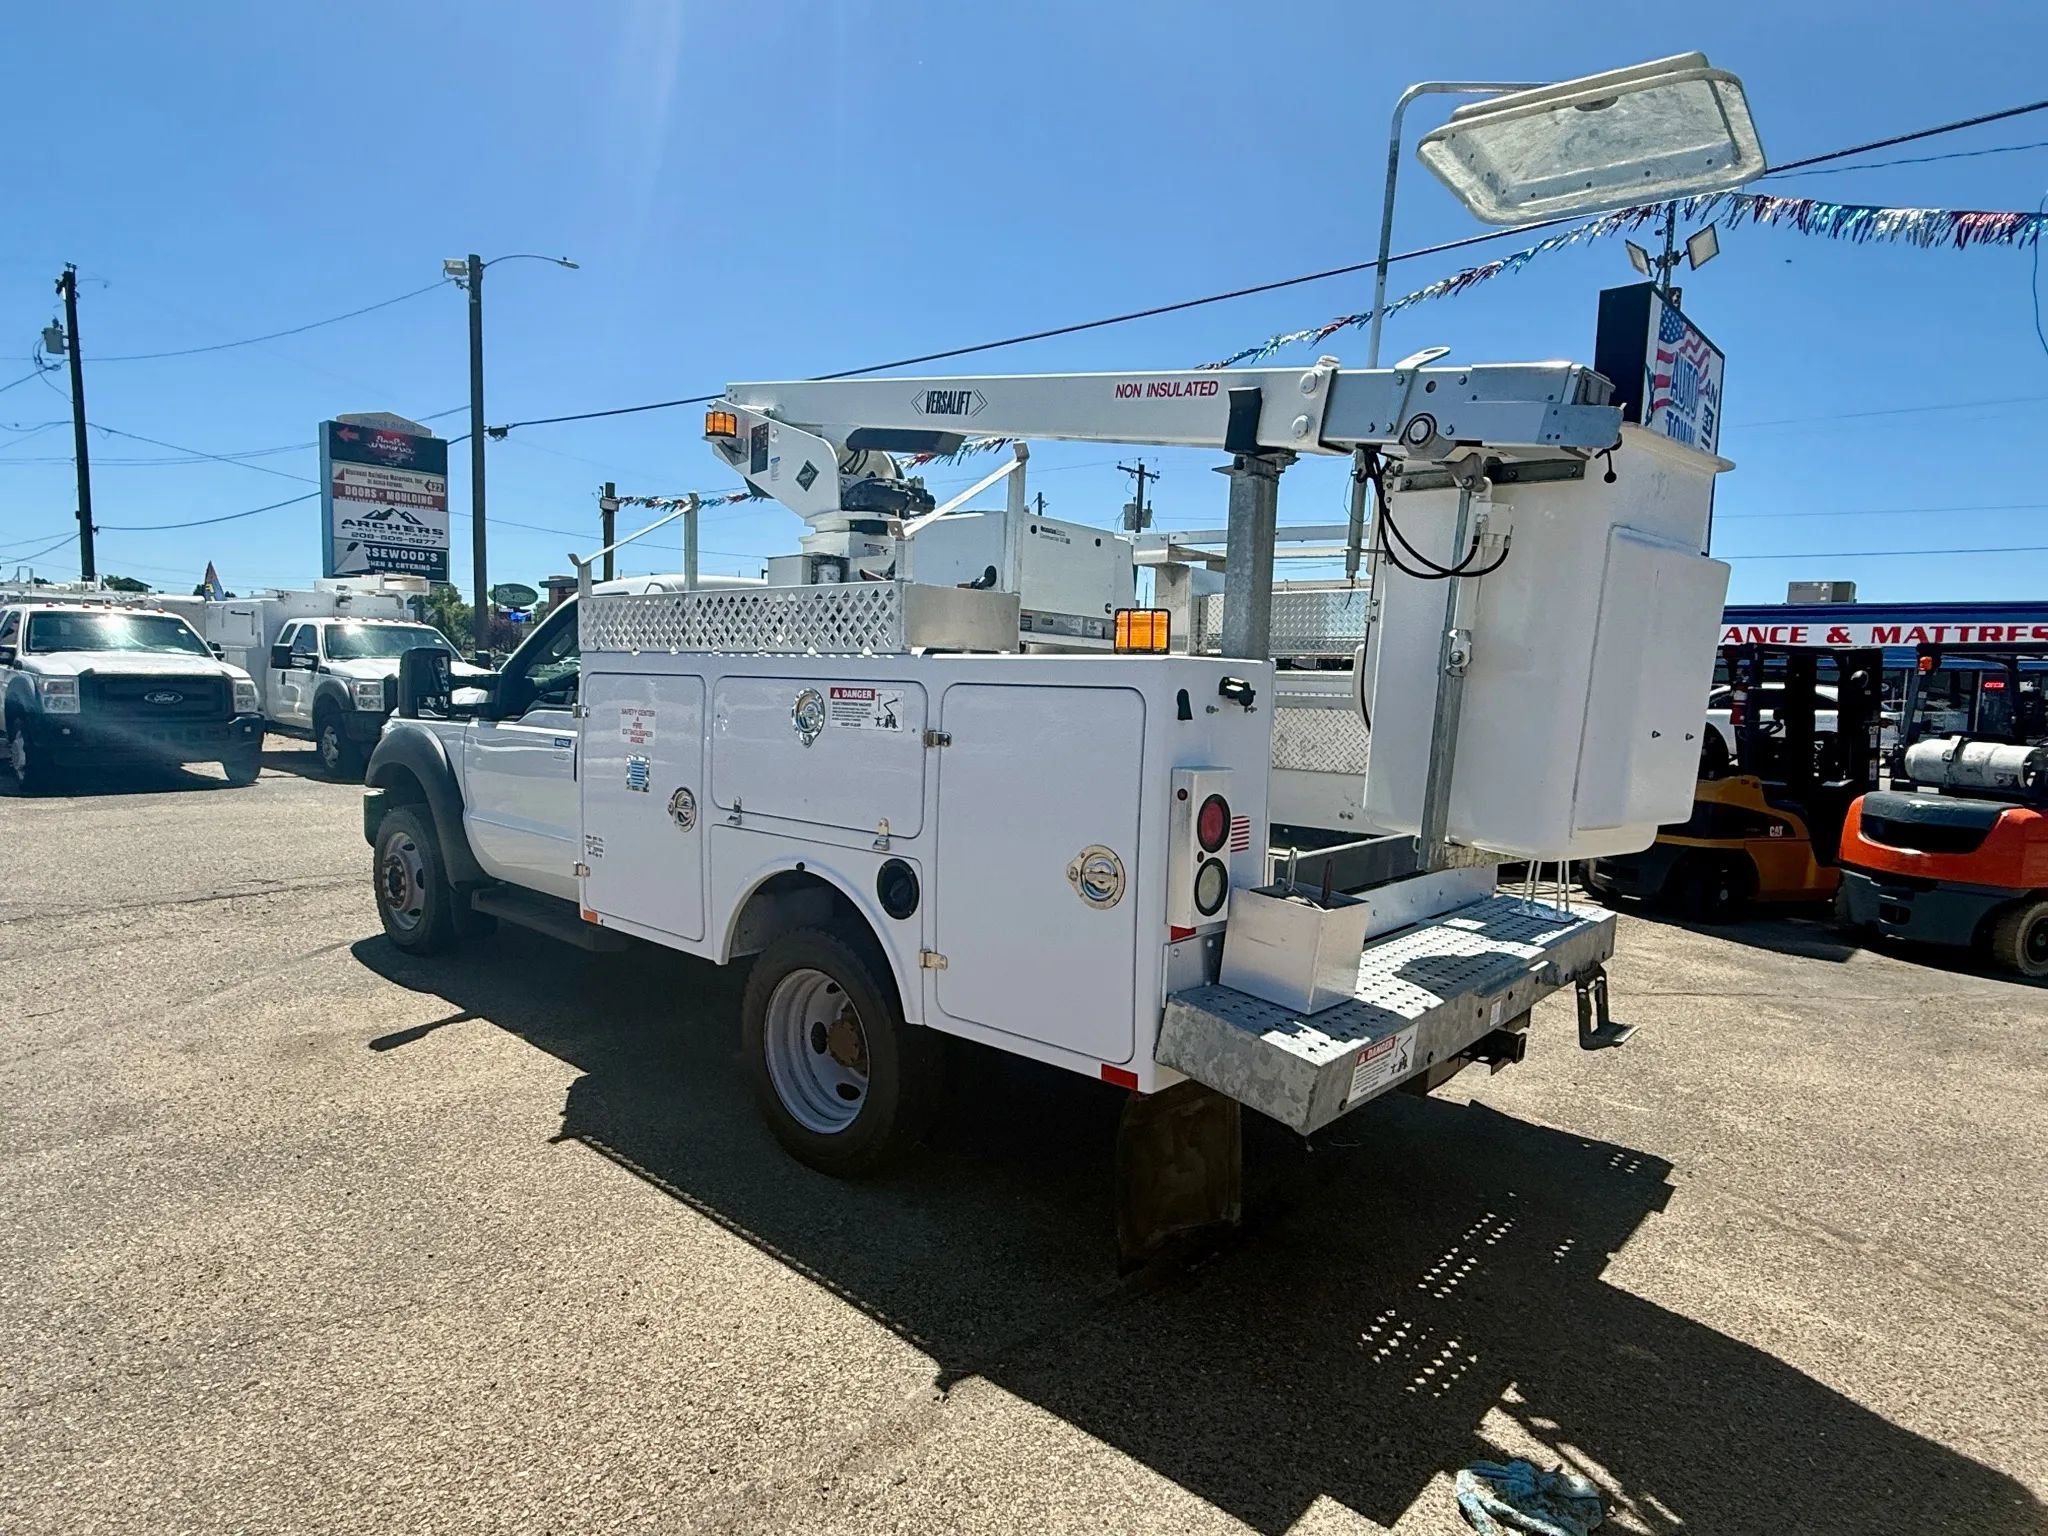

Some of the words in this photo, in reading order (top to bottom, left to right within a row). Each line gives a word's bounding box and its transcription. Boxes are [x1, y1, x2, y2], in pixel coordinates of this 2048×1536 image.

[1115, 384, 1142, 398] NON
[1146, 381, 1218, 397] INSULATED
[1670, 351, 1698, 417] AUTO
[926, 391, 972, 415] VERSALIFT
[345, 485, 377, 498] DOORS
[386, 490, 433, 505] MOULDING
[429, 482, 442, 492] 422
[342, 519, 444, 536] ARCHERS
[1826, 626, 1852, 643] &
[842, 689, 872, 699] DANGER
[1770, 825, 1783, 837] CAT
[1367, 1038, 1394, 1060] DANGER
